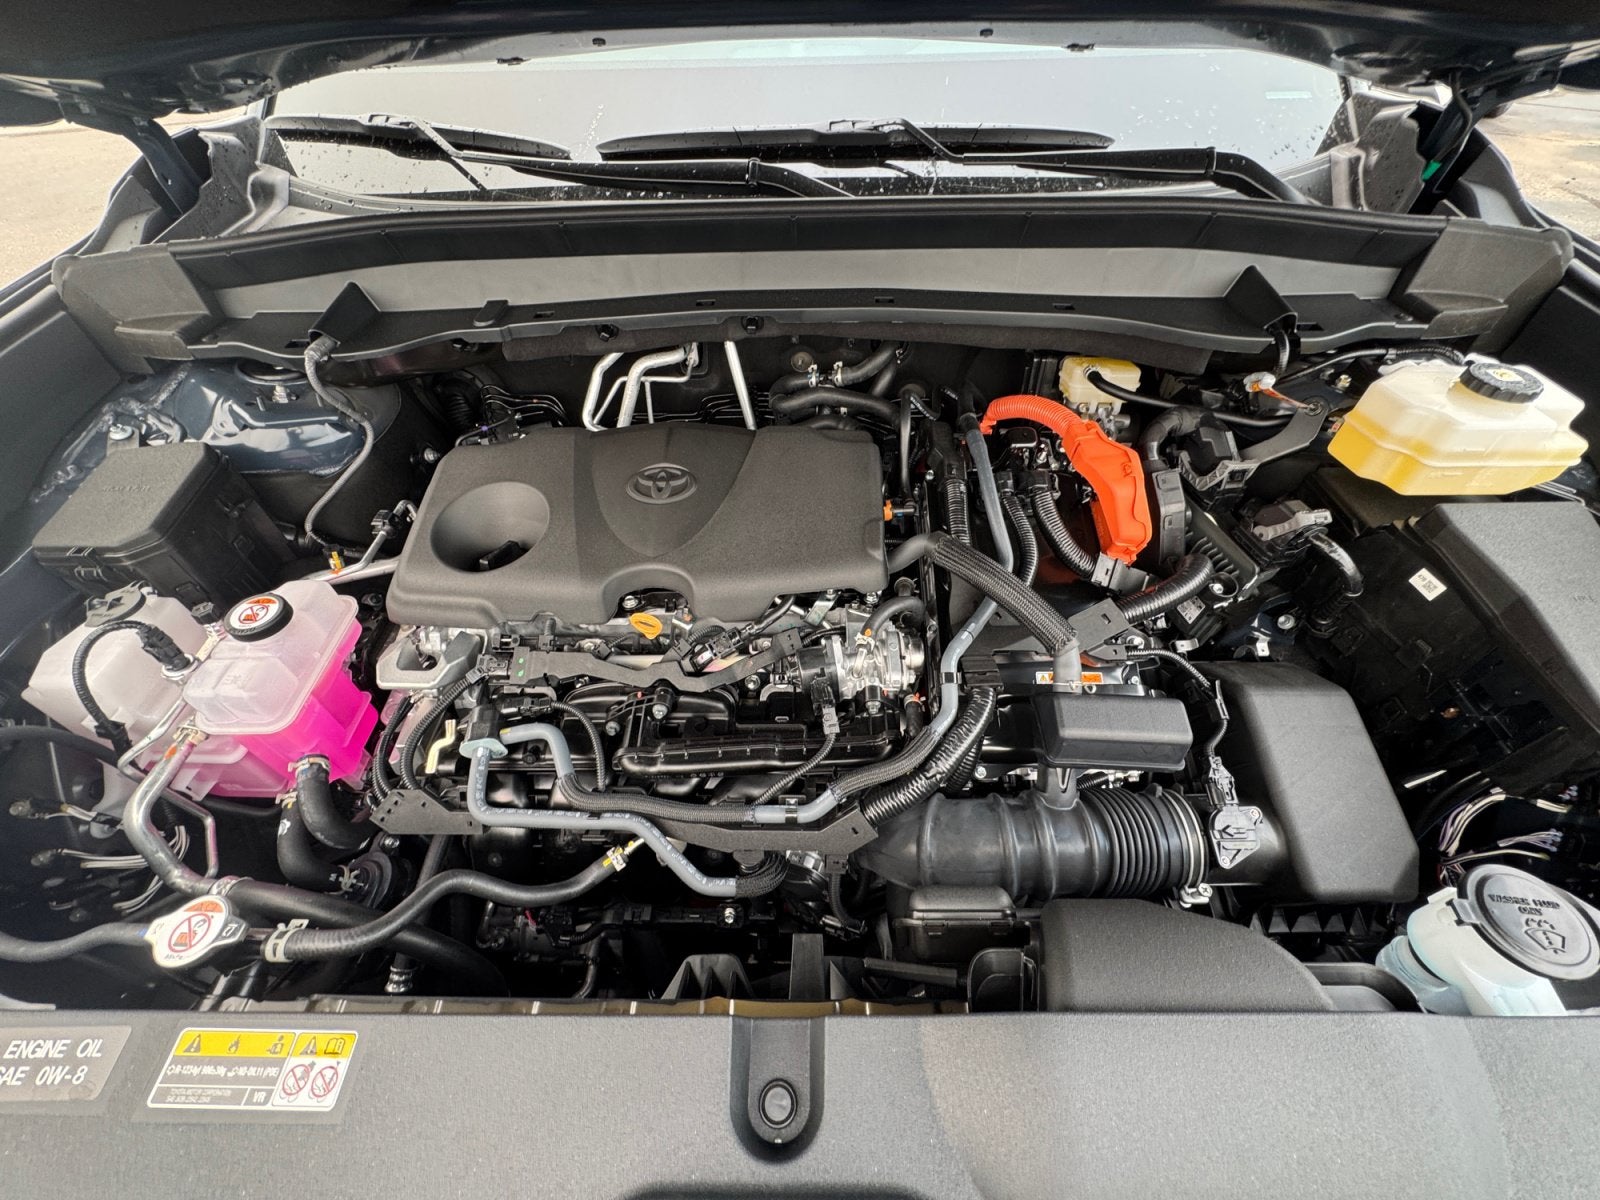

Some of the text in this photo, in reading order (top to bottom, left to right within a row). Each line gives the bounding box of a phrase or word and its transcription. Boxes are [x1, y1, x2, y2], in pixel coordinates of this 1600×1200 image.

[3, 1038, 103, 1059] ENGINE OIL
[35, 1065, 88, 1086] 0W-8
